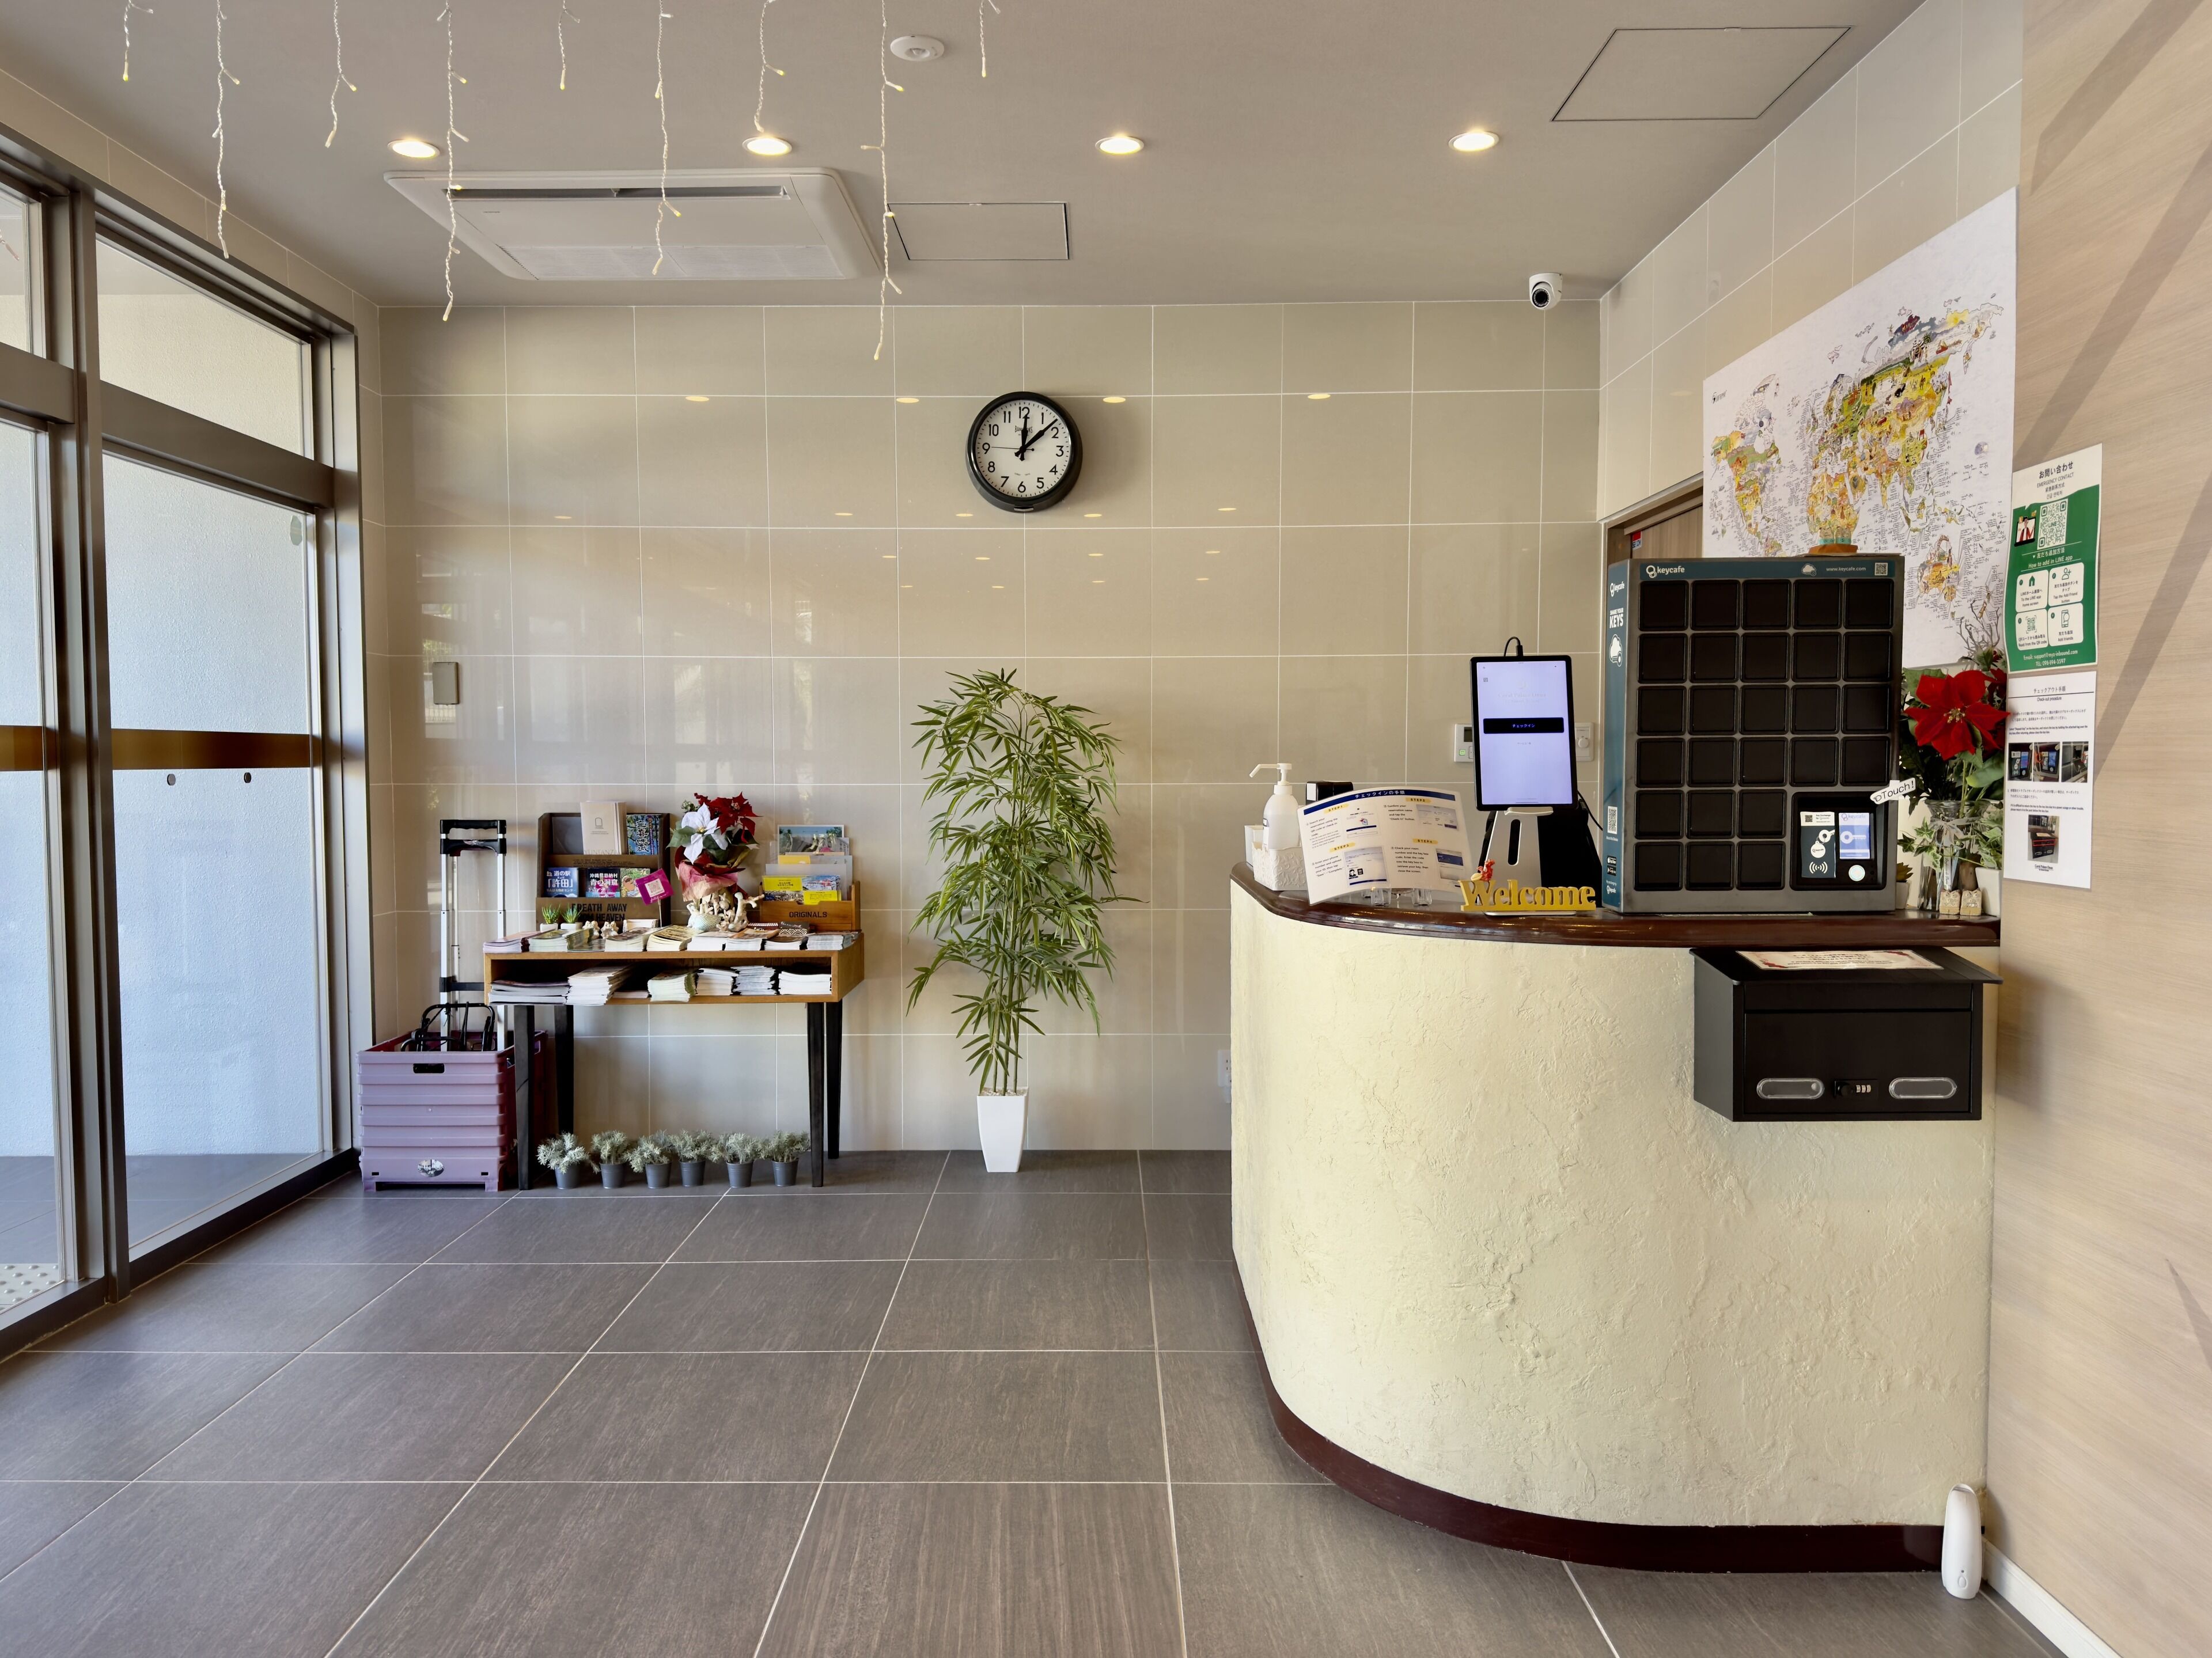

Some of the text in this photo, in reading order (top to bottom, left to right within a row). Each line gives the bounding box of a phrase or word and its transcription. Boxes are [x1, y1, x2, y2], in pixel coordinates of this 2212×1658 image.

[1003, 411, 1011, 423] 11
[1019, 407, 1030, 419] 12
[1041, 412, 1044, 424] 1
[989, 424, 999, 436] 10
[1051, 427, 1059, 438] 2
[983, 443, 990, 454] 9
[1056, 446, 1064, 457] 3
[988, 461, 995, 473] 8
[1050, 464, 1058, 475] 4
[2039, 461, 2073, 479] お問い合わせ
[1001, 476, 1009, 487] 7
[1036, 477, 1044, 488] 5
[2037, 472, 2074, 488] EMERGENCY CONTACT
[1018, 481, 1026, 492] 6
[1657, 566, 1685, 575] keycafe
[1614, 581, 1625, 593] keycafe
[1609, 613, 1623, 628] KEYS
[1355, 790, 1406, 799] チェックインの手順
[1881, 780, 1914, 799] Touch!
[1459, 878, 1596, 912] Welcome
[607, 904, 627, 912] AWAY
[596, 913, 625, 921] HEAVEN
